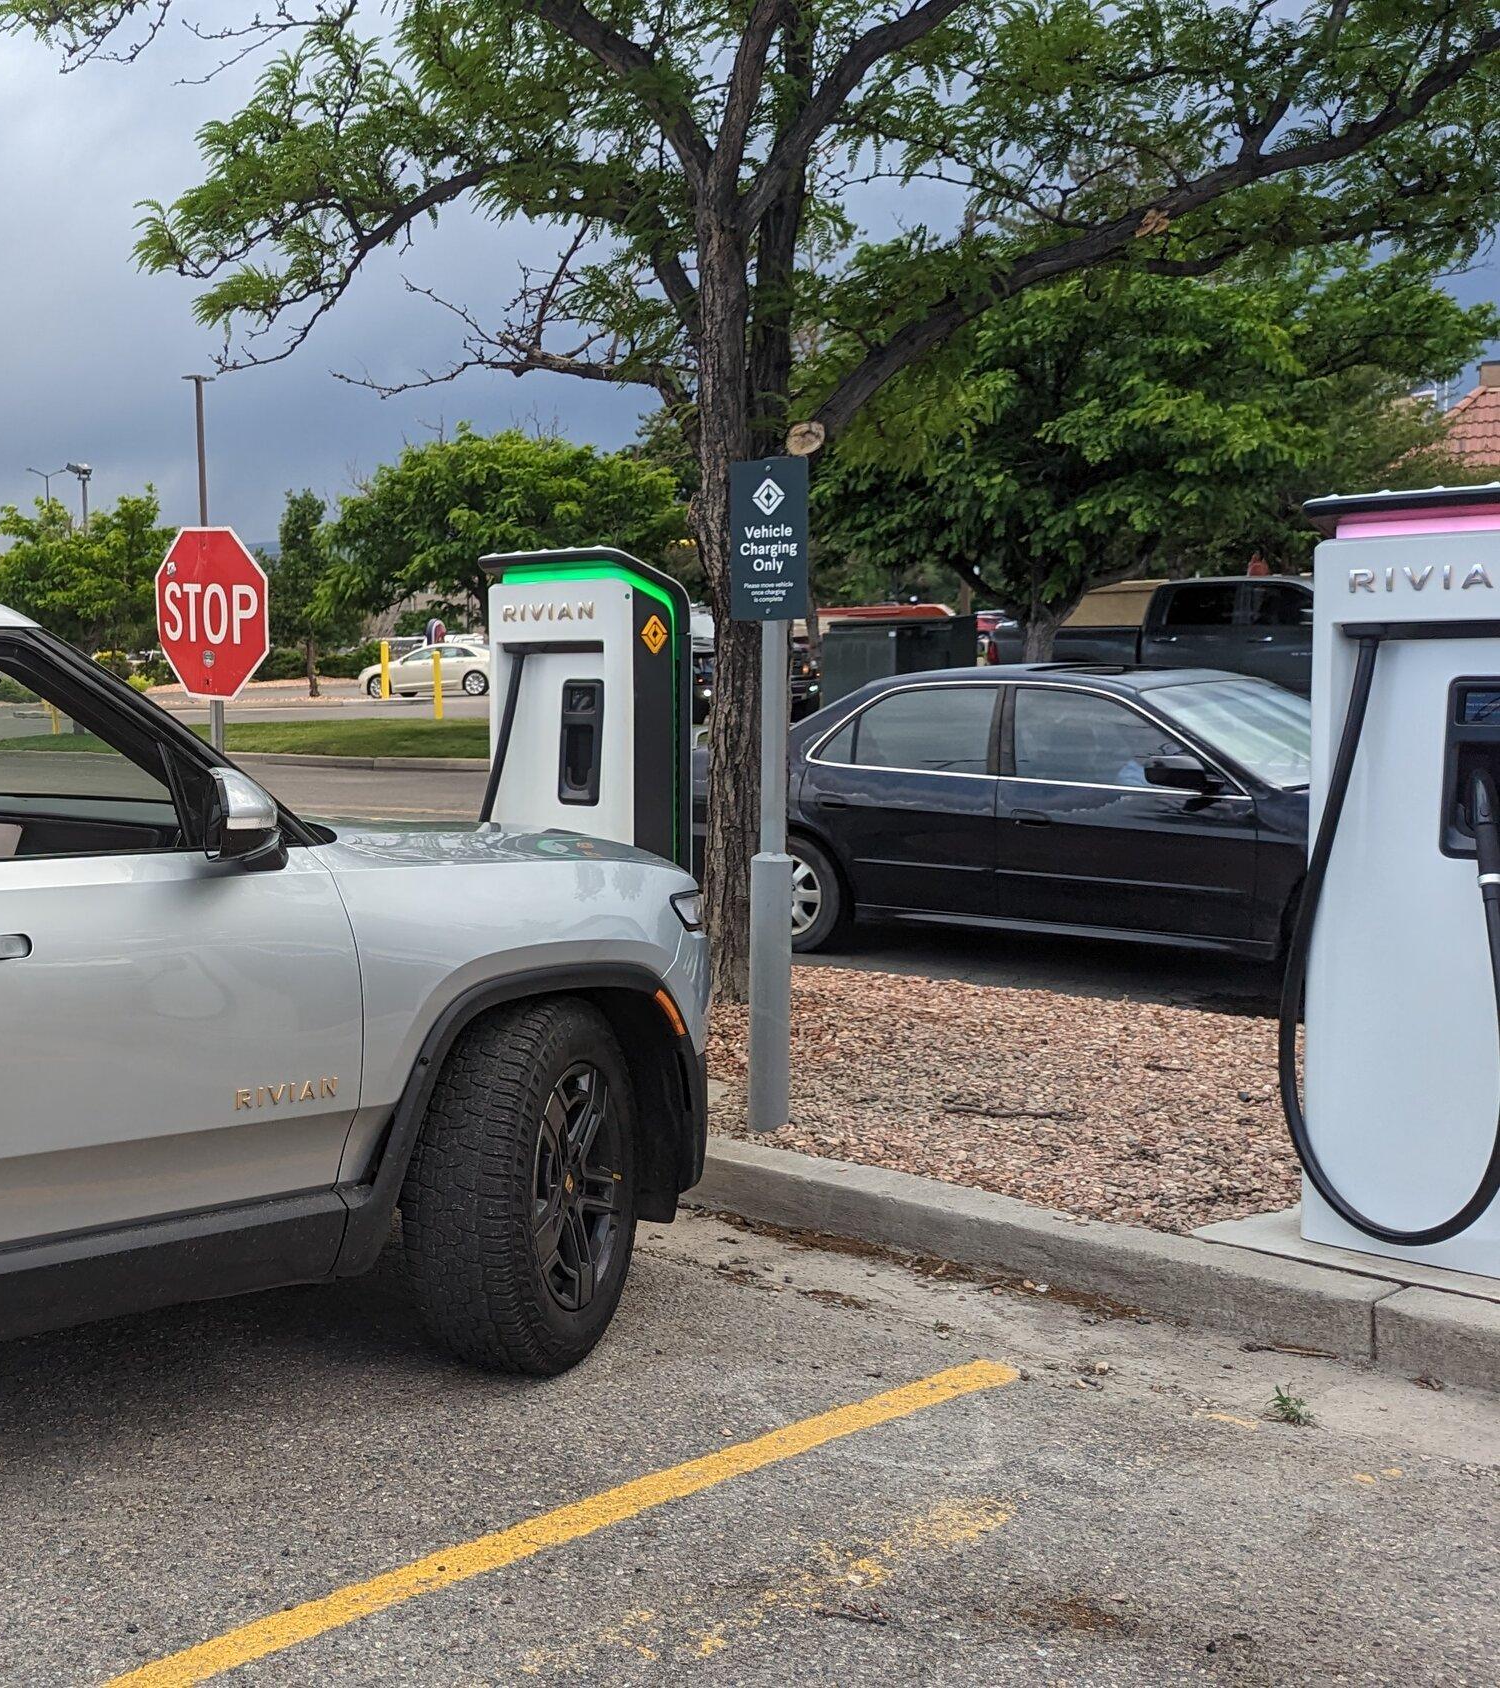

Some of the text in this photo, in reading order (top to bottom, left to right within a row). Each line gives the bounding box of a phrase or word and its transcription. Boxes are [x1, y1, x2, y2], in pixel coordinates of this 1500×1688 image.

[744, 523, 793, 539] Vehicle
[740, 540, 798, 558] Charging
[753, 558, 784, 574] Only
[759, 595, 784, 603] complete
[764, 588, 786, 597] charging
[164, 581, 259, 645] STOP
[502, 601, 594, 622] RIVIAN
[235, 1076, 338, 1110] RIVIAN
